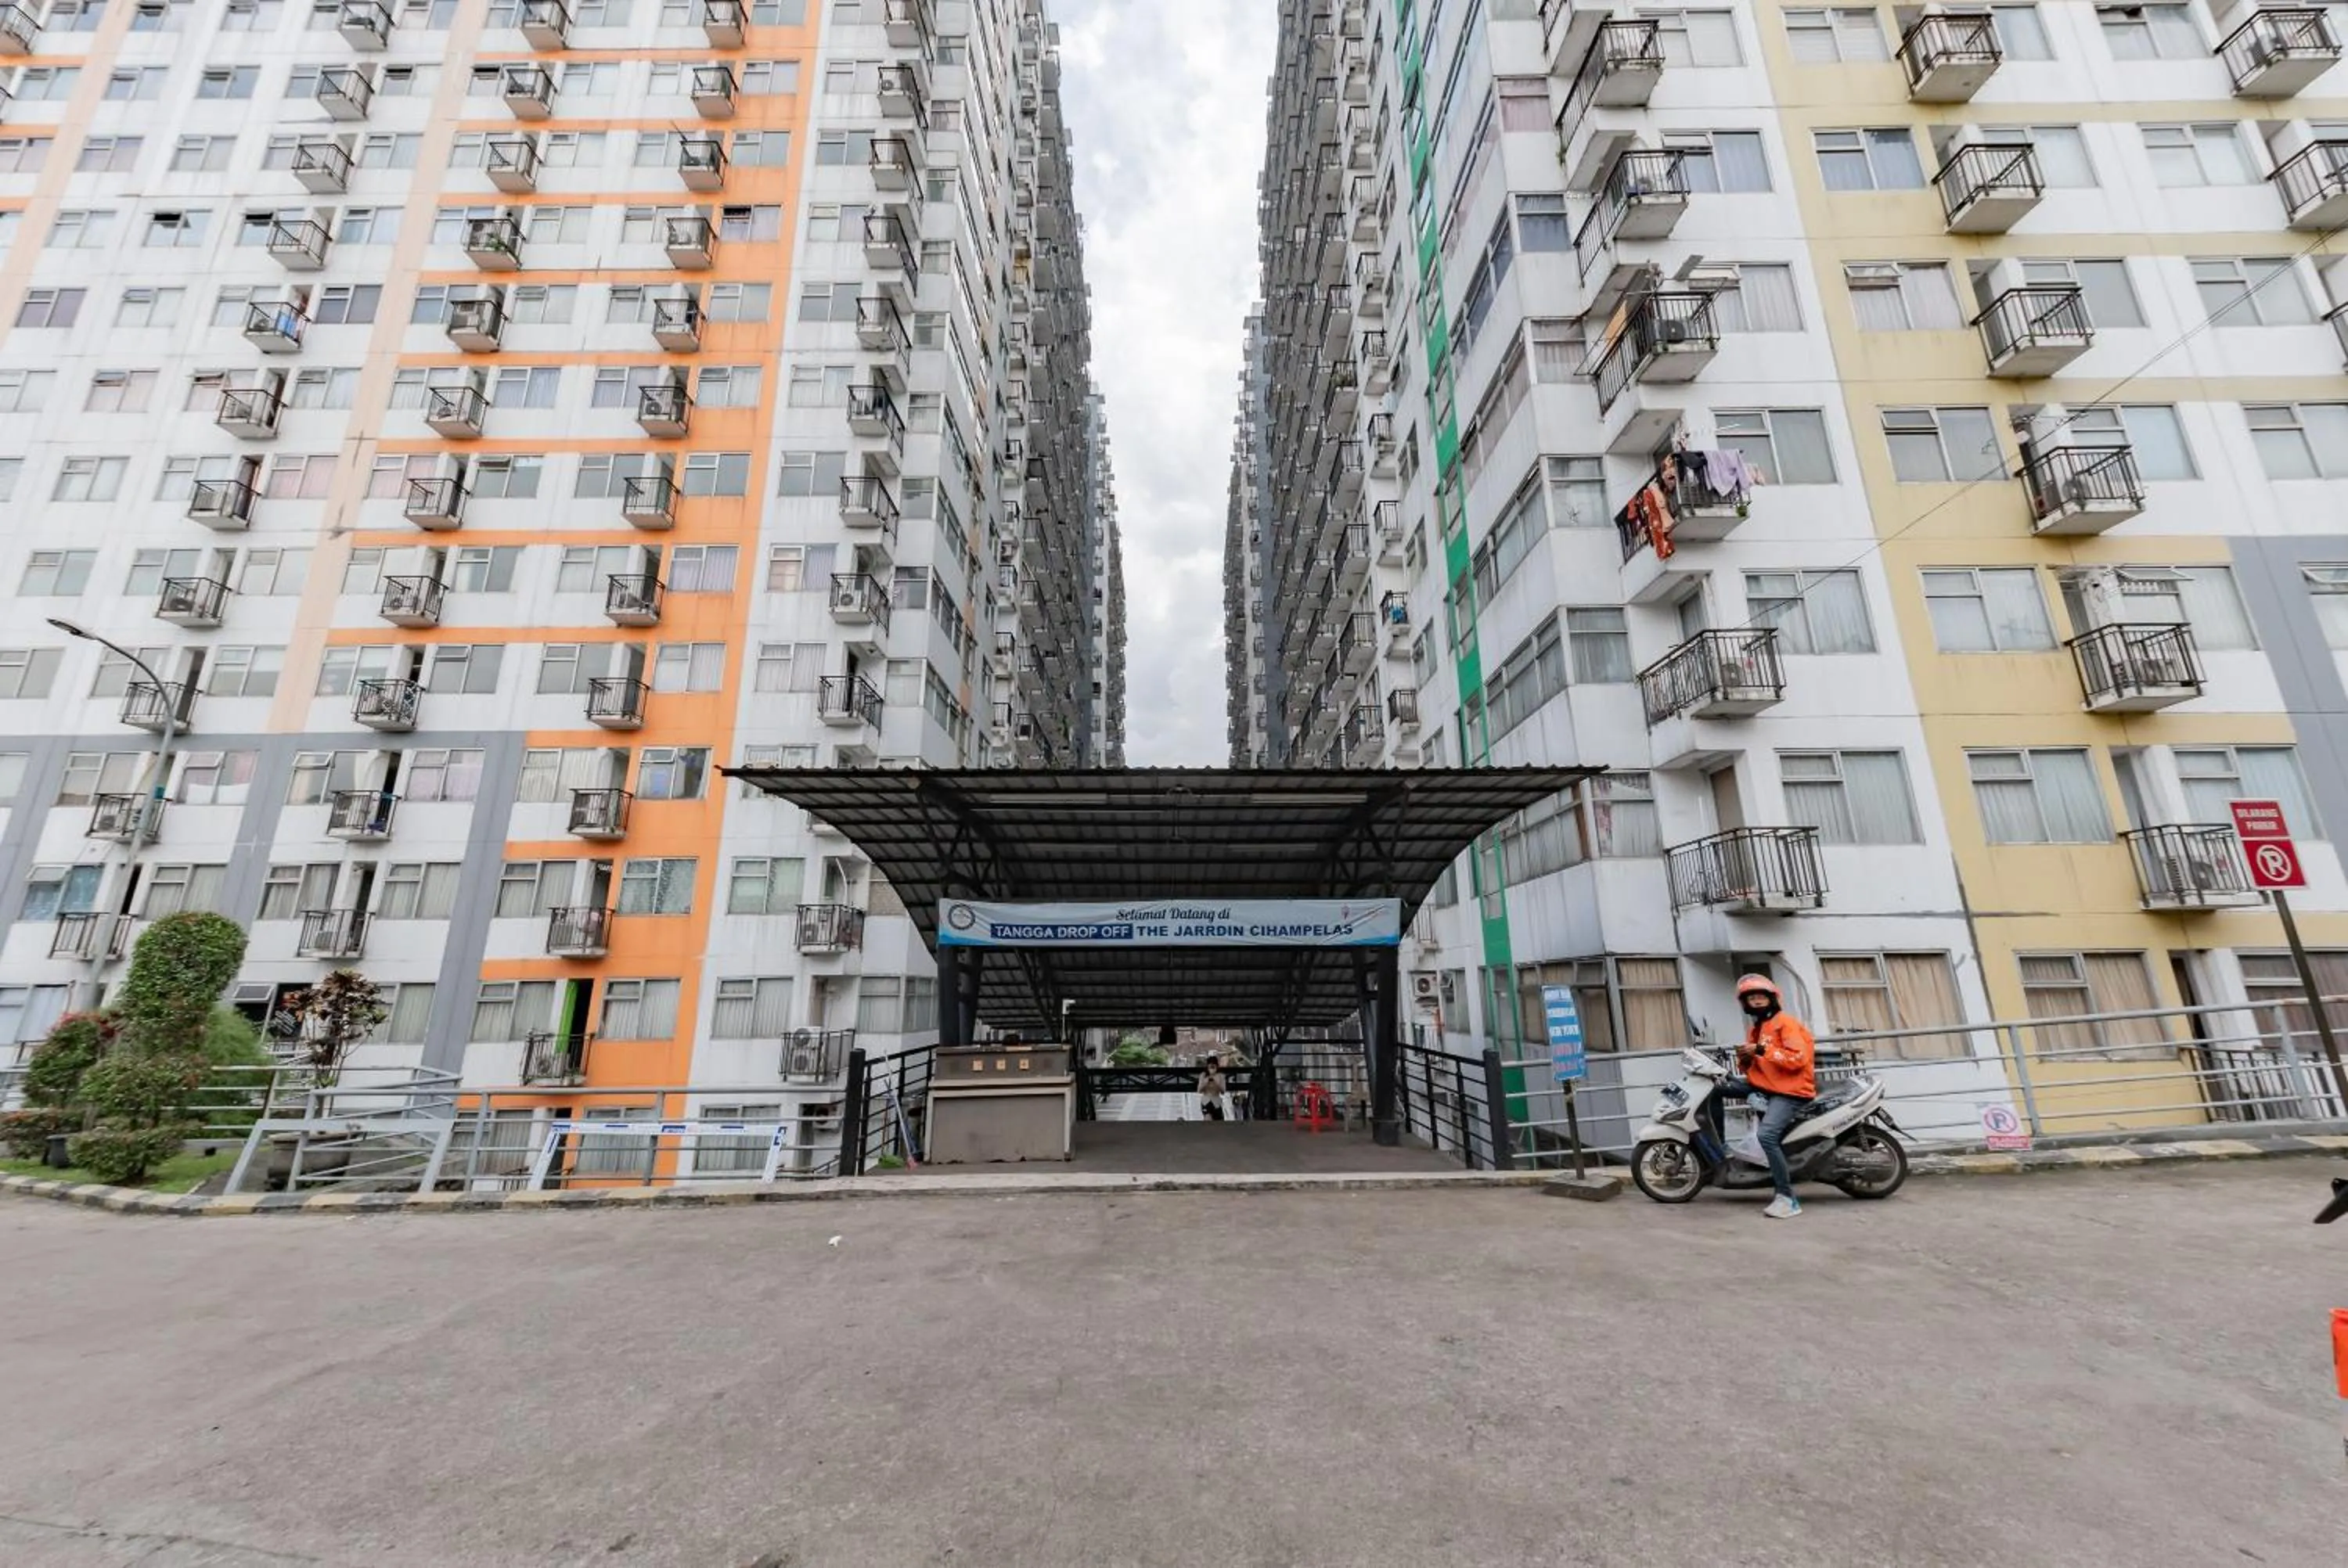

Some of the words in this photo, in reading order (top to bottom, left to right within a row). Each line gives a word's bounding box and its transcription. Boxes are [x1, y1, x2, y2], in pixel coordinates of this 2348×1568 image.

[1115, 908, 1166, 920] Selamat
[1170, 908, 1215, 922] Datang
[1218, 908, 1230, 919] di
[996, 926, 1054, 937] TANGGA
[1057, 926, 1097, 937] DROP
[1101, 926, 1129, 937] OFF
[1137, 926, 1169, 937] THE
[1174, 926, 1244, 937] JARRDIN
[1250, 924, 1353, 937] CIHAMPELAS
